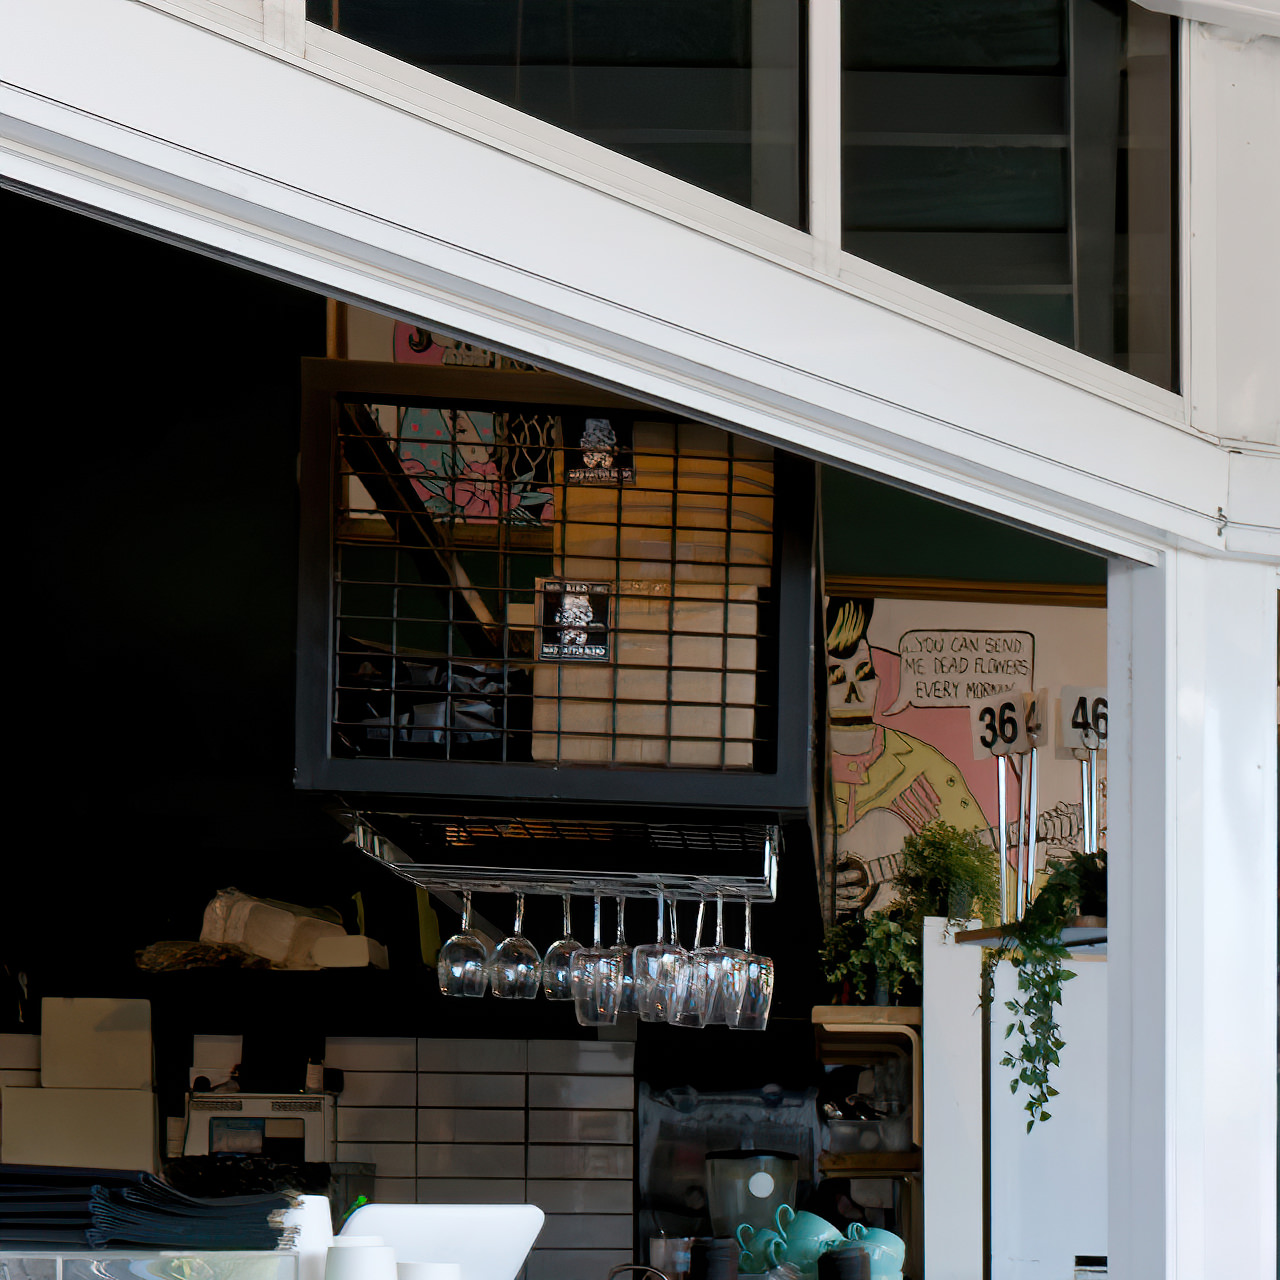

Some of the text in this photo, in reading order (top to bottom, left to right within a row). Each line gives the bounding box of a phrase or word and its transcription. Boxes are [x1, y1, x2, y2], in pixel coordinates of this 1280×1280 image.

[951, 637, 979, 653] CAN
[985, 637, 1022, 653] SEND
[905, 656, 1031, 675] ME DEAD FLOWERS
[916, 680, 959, 699] EVERY
[979, 702, 1018, 748] 36
[1072, 696, 1108, 740] 46
